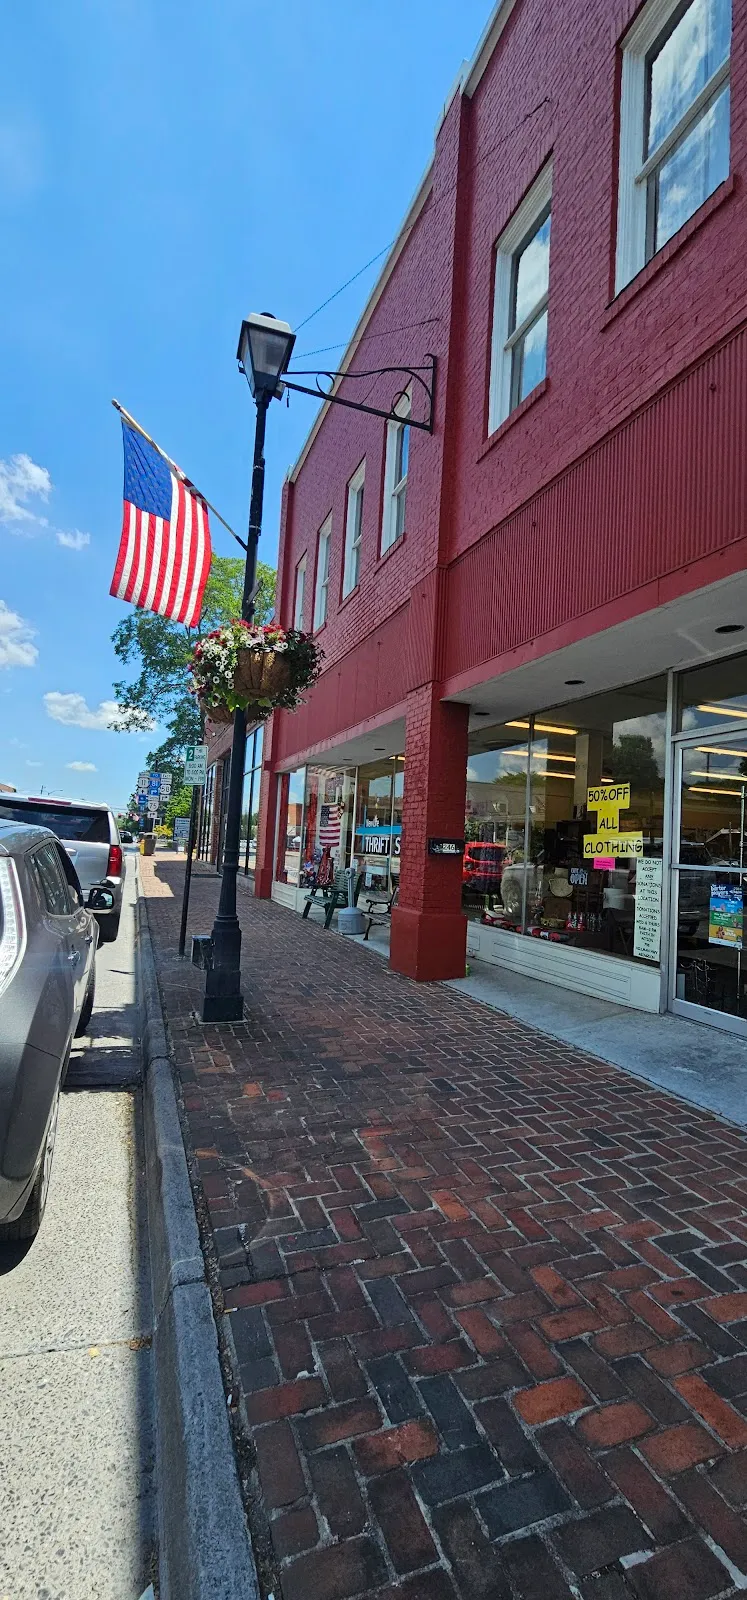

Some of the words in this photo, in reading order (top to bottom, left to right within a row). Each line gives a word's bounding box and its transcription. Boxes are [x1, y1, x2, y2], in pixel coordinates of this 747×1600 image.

[188, 750, 193, 759] 2
[599, 817, 617, 829] ALL
[365, 836, 389, 853] THRIFT
[585, 840, 642, 853] CLOTHING
[570, 873, 588, 885] OPEN
